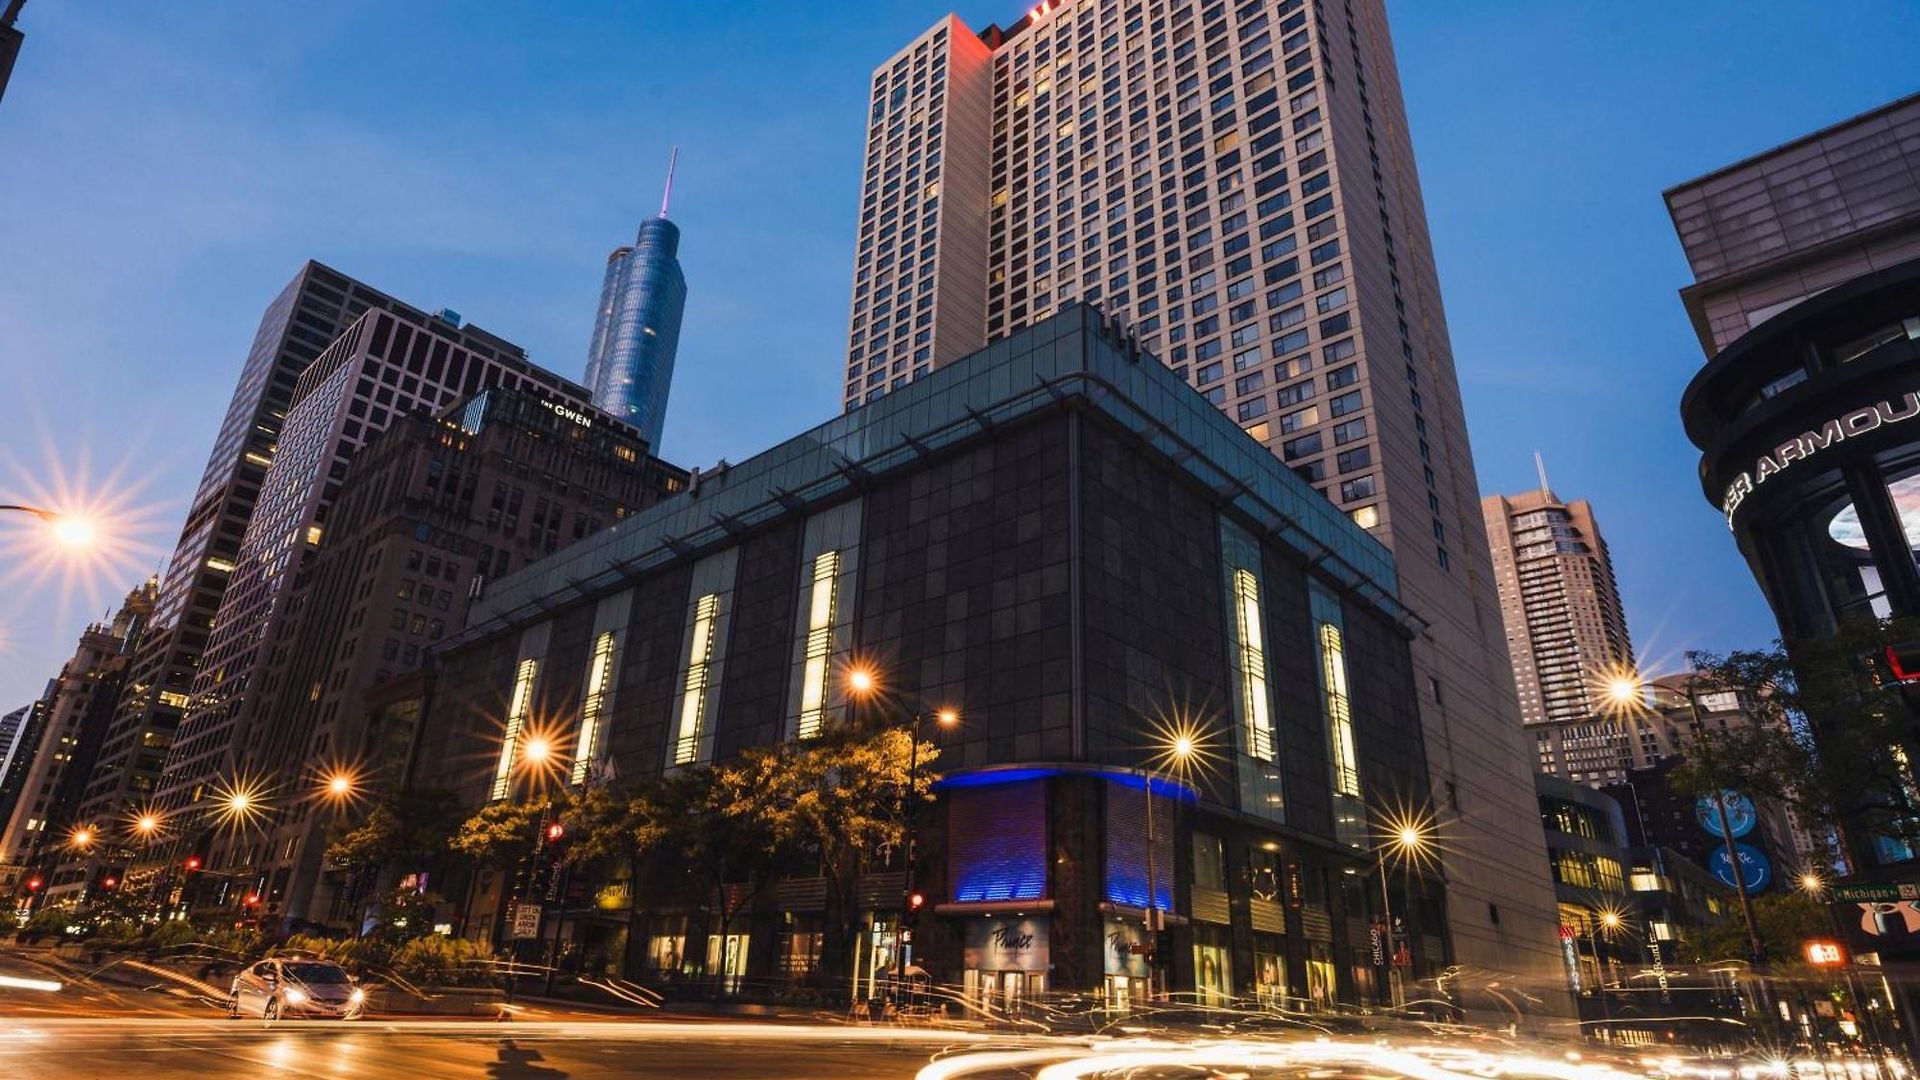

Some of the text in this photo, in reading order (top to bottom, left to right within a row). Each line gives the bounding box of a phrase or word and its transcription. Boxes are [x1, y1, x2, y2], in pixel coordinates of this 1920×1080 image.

[555, 405, 591, 428] GWEN
[1756, 392, 1920, 485] ARMOU
[1842, 889, 1889, 901] Michigan
[1370, 929, 1381, 966] CHICAGO
